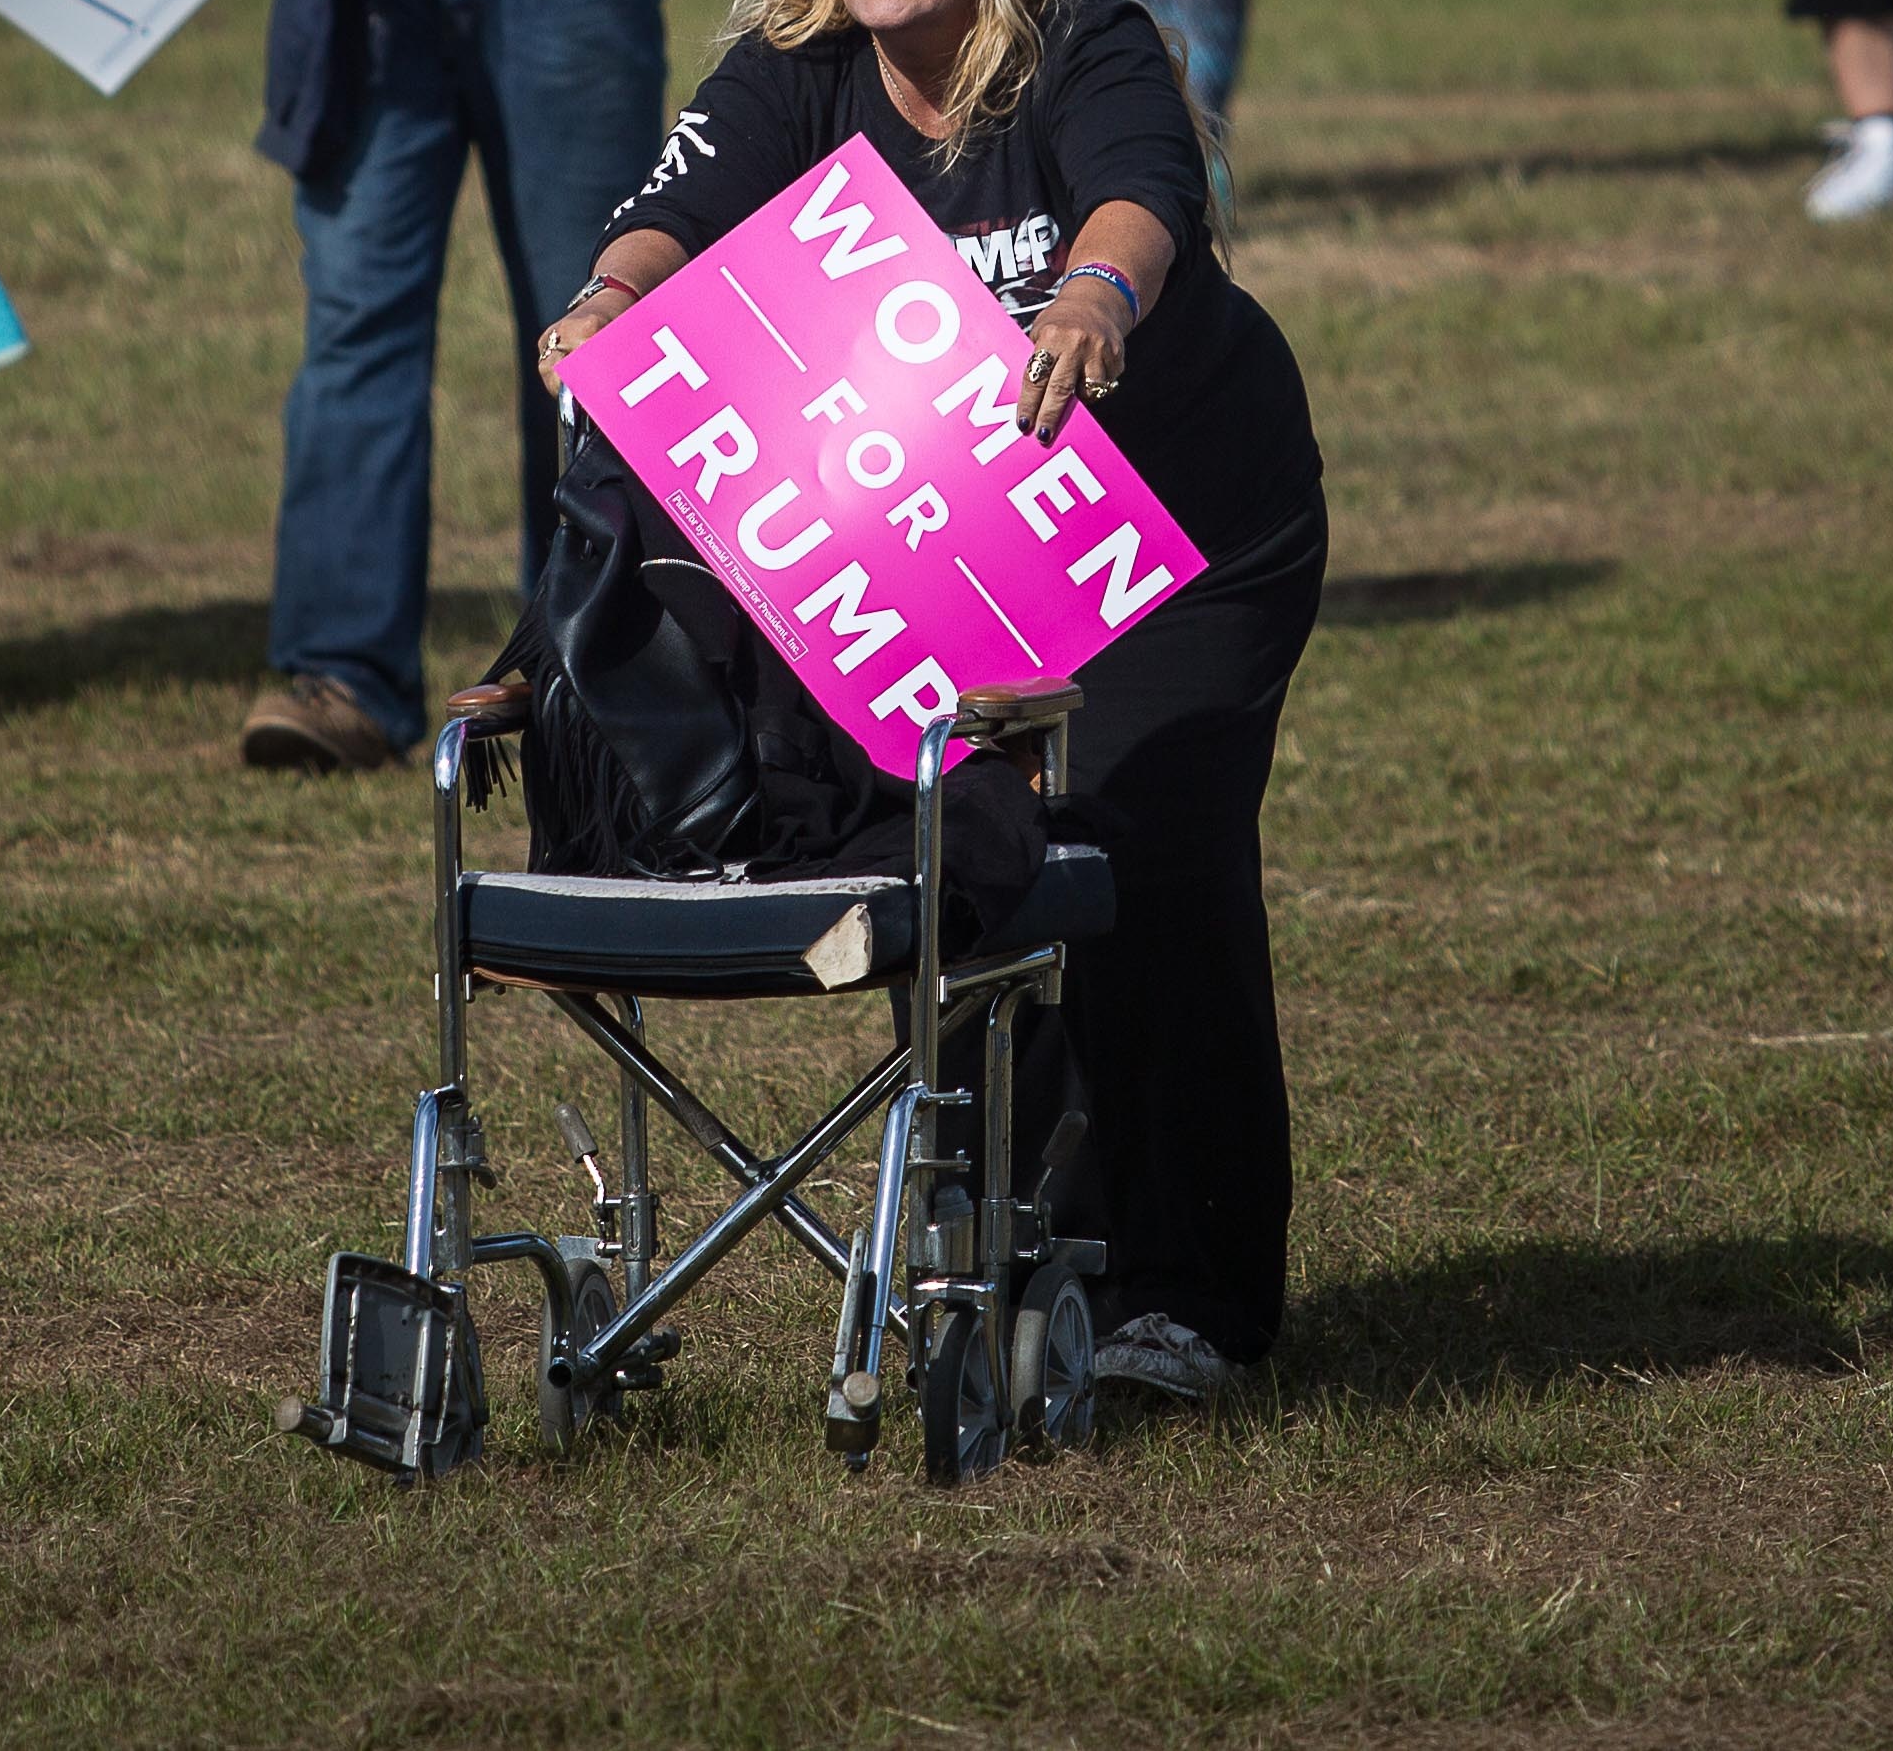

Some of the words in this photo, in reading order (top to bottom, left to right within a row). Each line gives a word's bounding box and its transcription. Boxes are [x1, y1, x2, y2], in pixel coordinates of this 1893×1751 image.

[1071, 267, 1117, 284] TRUMP
[790, 160, 1175, 629] WOMEN
[802, 377, 950, 552] FOR
[618, 326, 959, 732] TRUMP
[672, 495, 690, 515] Paid
[686, 512, 698, 526] for
[695, 522, 706, 536] by
[704, 533, 729, 562] Donald
[729, 566, 751, 593] Trump
[748, 590, 761, 605] for
[758, 602, 788, 640] President,
[787, 638, 800, 655] Inc.
